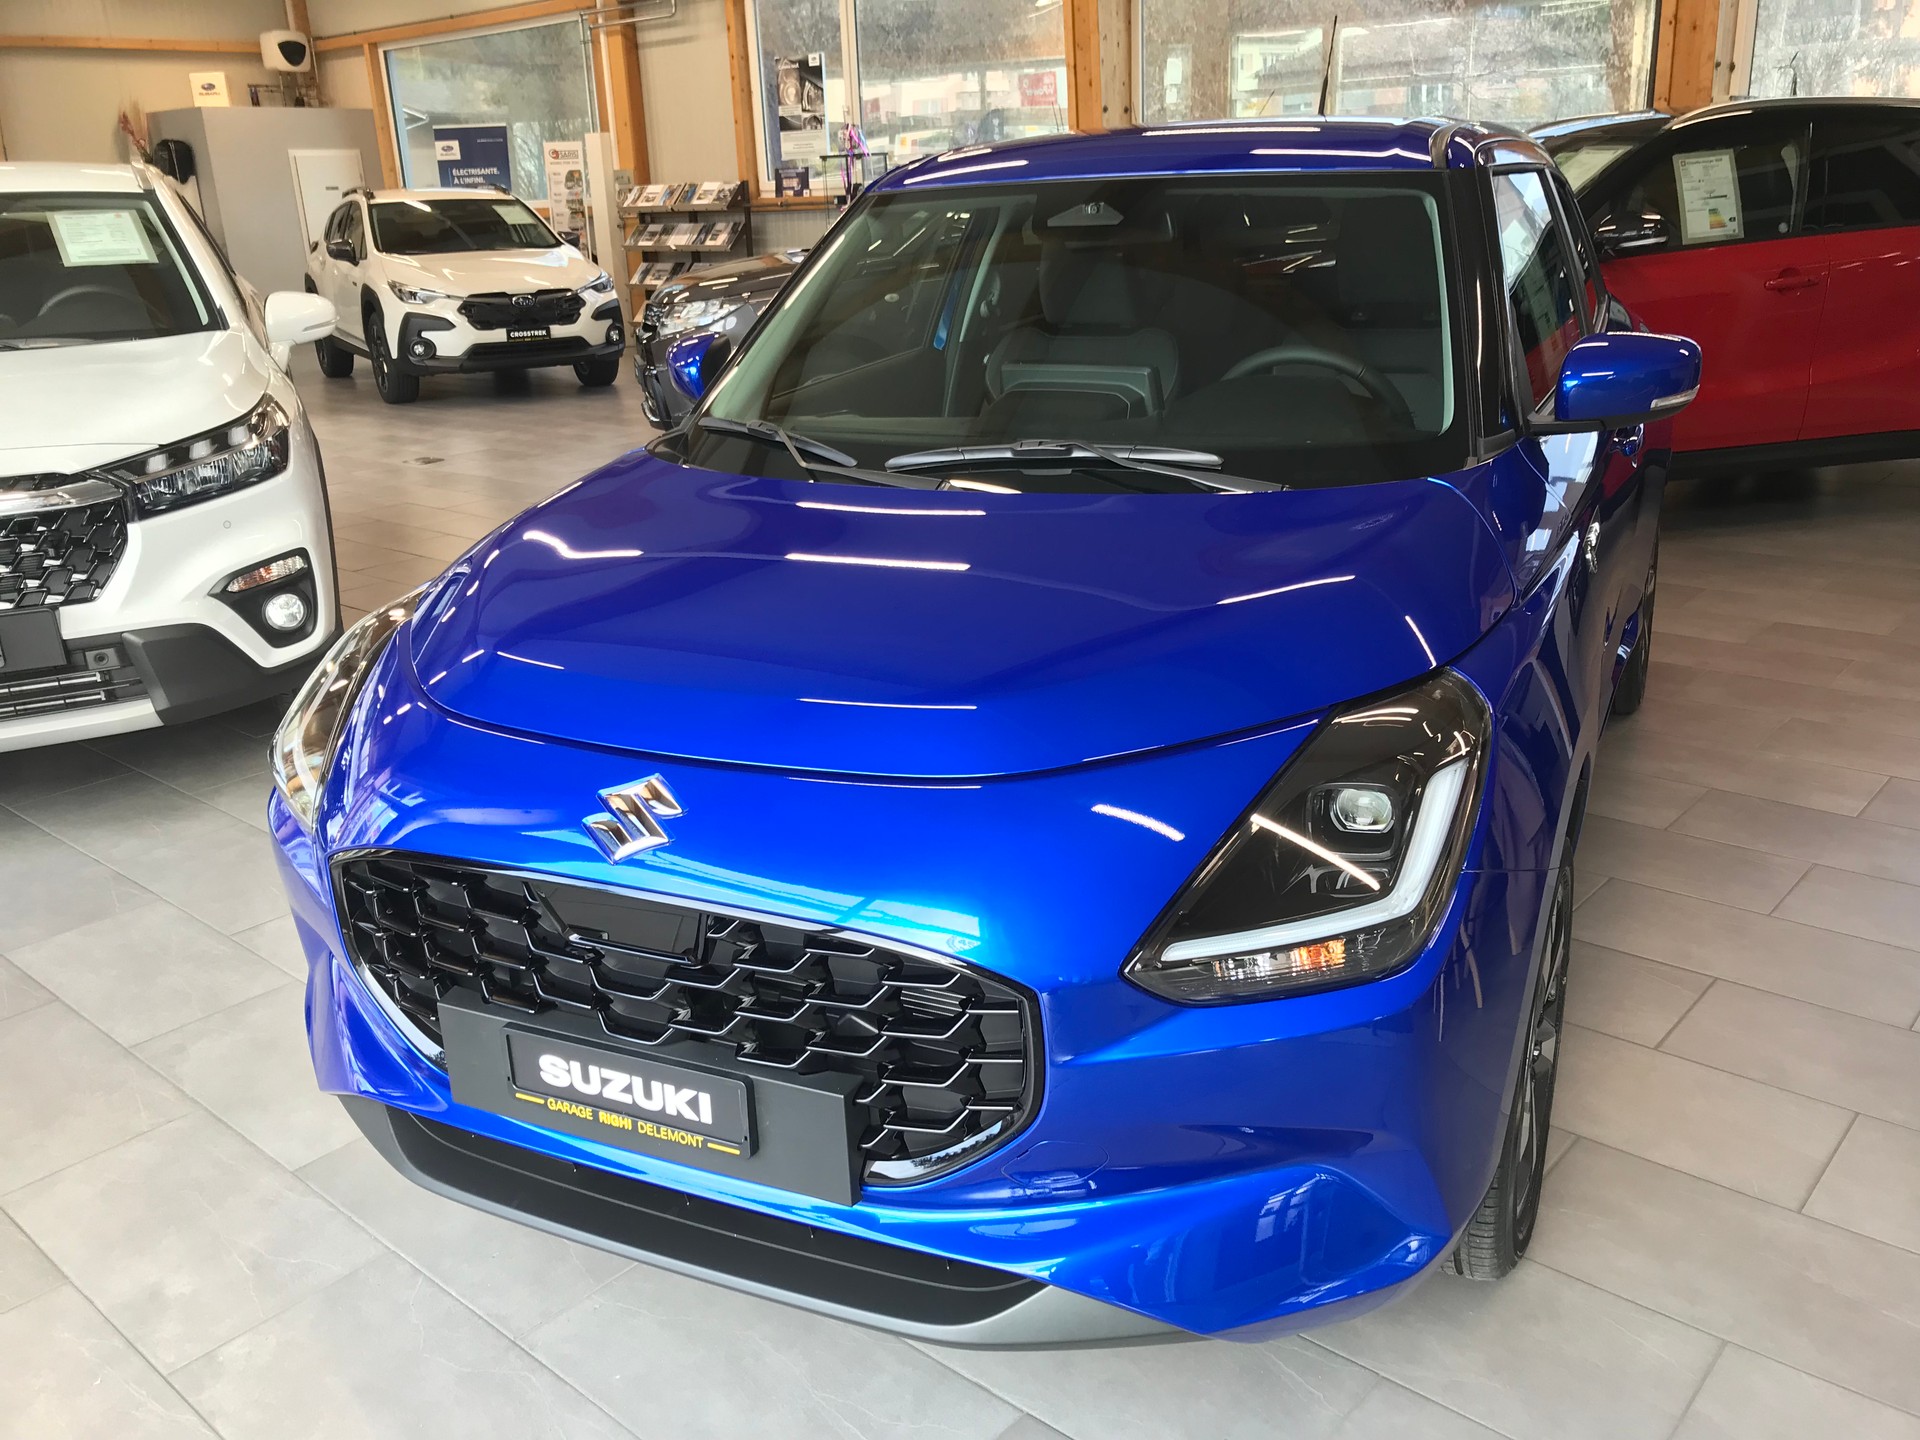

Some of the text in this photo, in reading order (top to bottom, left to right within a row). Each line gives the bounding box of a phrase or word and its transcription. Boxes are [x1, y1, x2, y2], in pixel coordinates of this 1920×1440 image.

[452, 167, 500, 176] ÉLECTRISANTE.
[454, 176, 486, 185] À L'INFINI.
[510, 330, 547, 338] CROSSTREK
[539, 1054, 712, 1125] SUZUKI
[547, 1097, 704, 1149] GARAGE RIGHI DELEMONT
